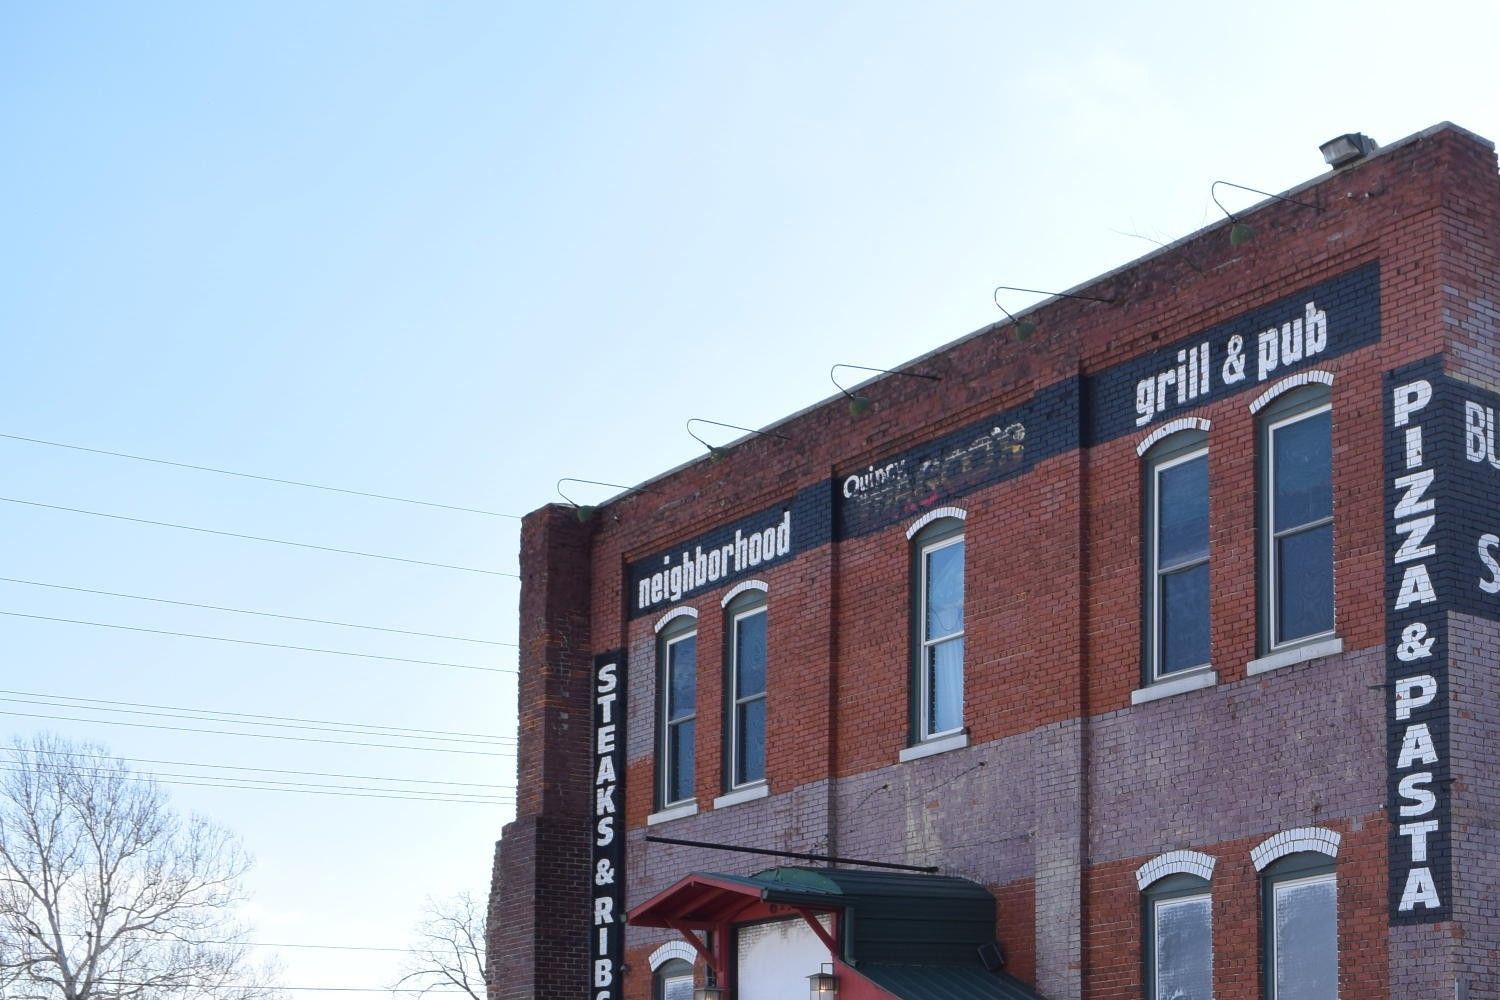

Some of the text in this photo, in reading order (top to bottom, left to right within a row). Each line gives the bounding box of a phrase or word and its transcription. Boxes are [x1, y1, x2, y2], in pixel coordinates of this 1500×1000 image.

[1135, 301, 1327, 427] grill & pub
[638, 510, 791, 608] neighborhood
[1393, 380, 1441, 911] PIZZA & PASTA
[596, 663, 617, 846] STEAKS
[595, 858, 615, 886] &
